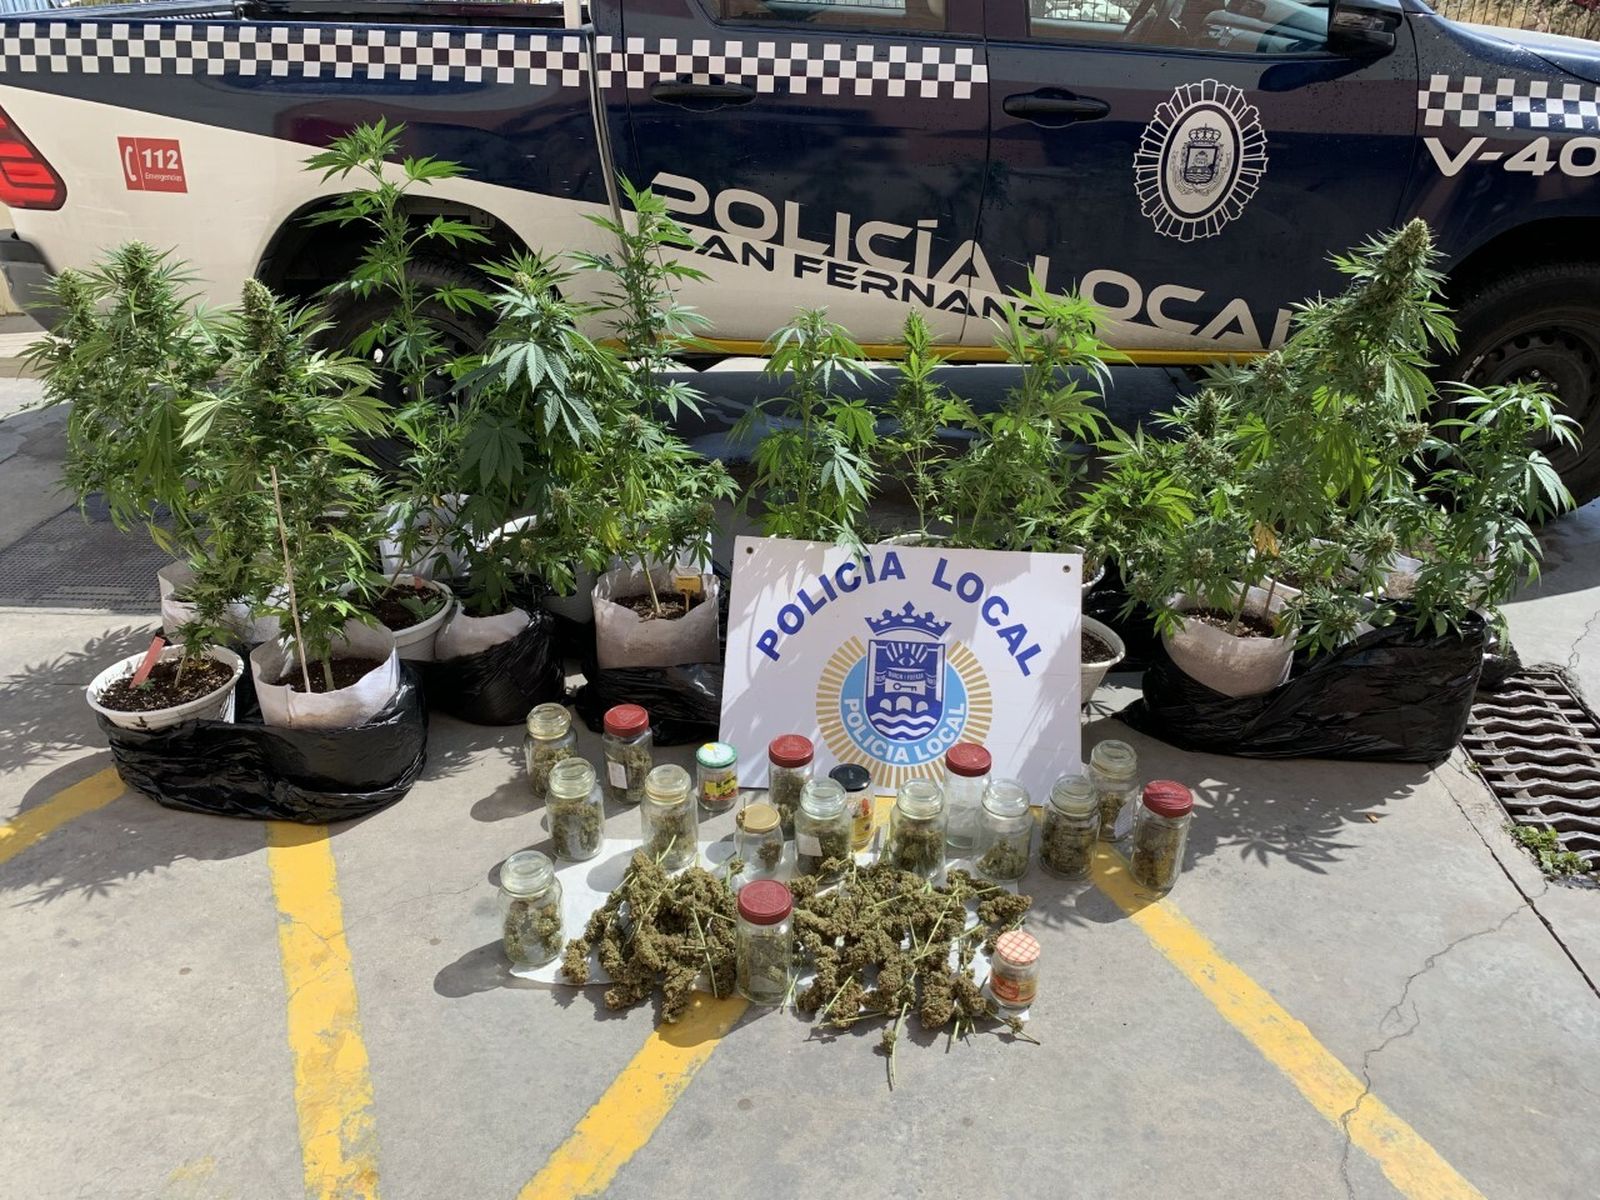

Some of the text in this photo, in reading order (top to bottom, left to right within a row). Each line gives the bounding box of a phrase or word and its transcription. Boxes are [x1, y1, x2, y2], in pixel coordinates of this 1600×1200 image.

[141, 148, 179, 170] 112
[651, 171, 1002, 294] POLICÍA
[755, 551, 1043, 677] POLICIA LOCAL
[844, 698, 965, 763] POLICIA LOCAL
